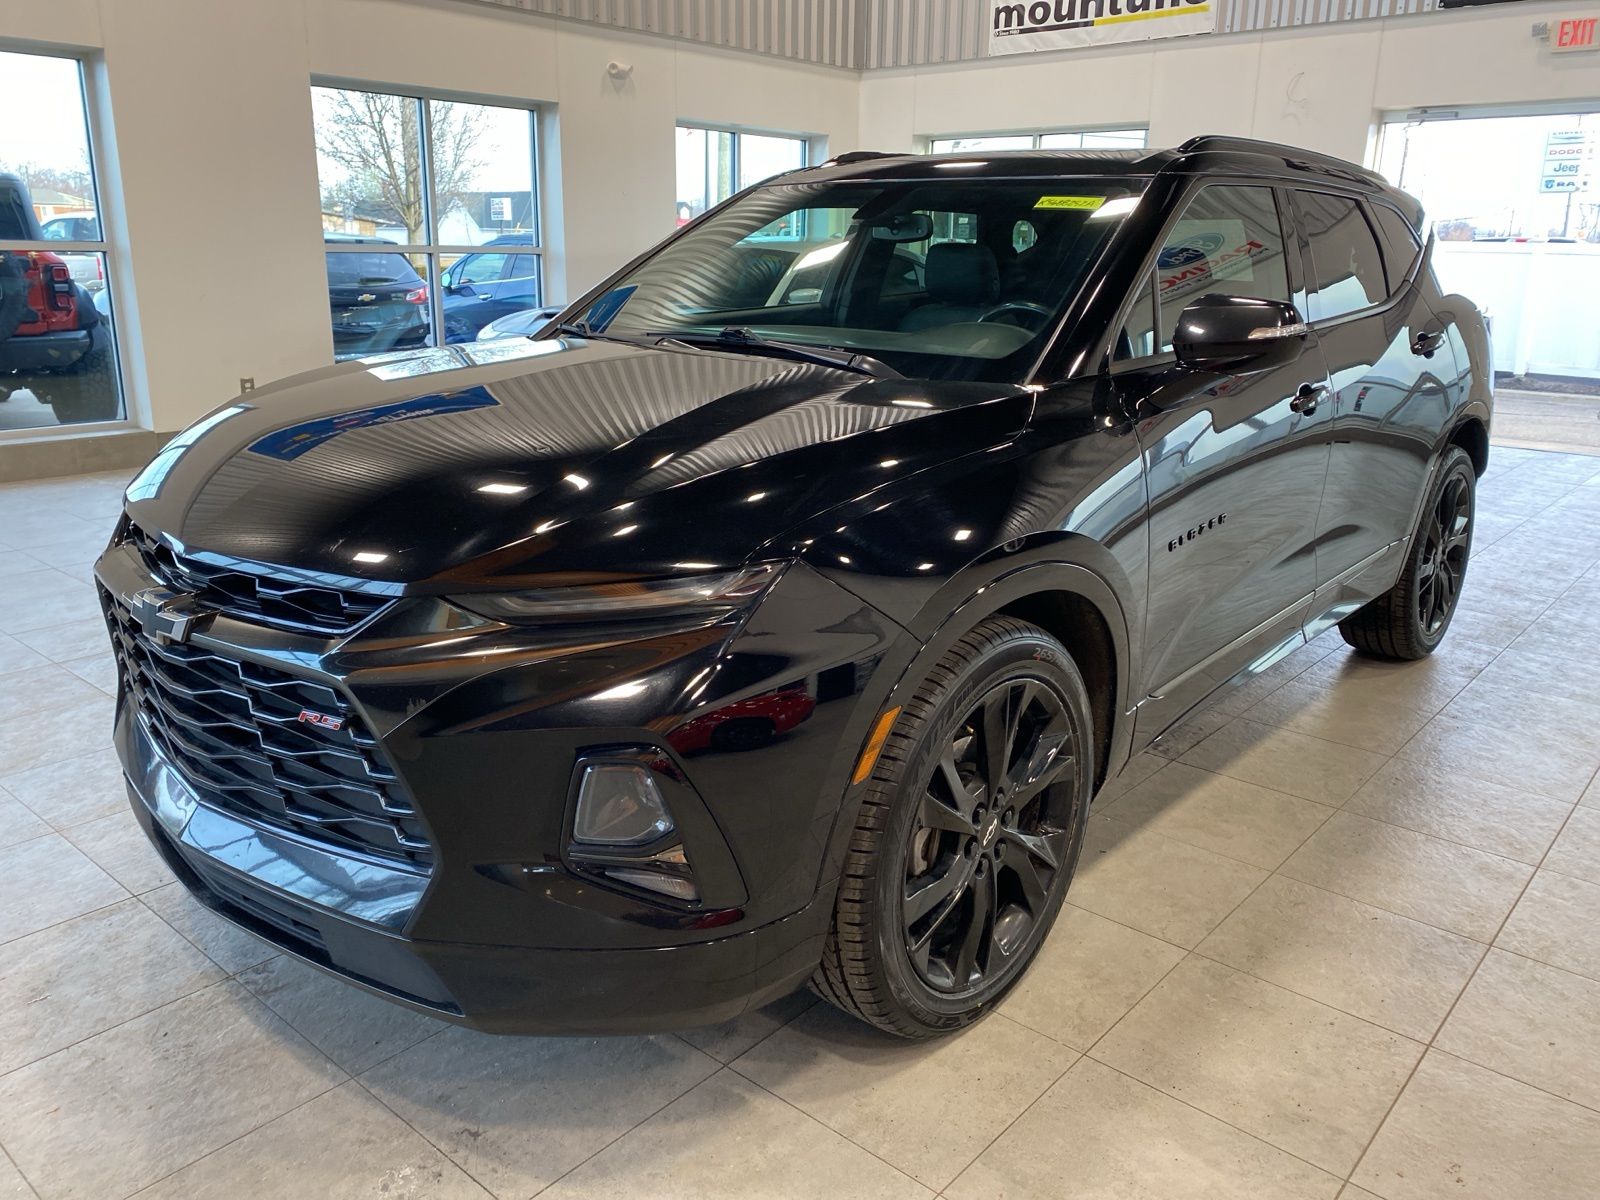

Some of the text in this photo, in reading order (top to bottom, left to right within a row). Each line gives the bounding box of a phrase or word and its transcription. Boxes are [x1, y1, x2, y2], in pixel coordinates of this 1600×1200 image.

[994, 0, 1207, 29] mountu
[1558, 19, 1597, 47] EXIT
[298, 710, 343, 731] RS
